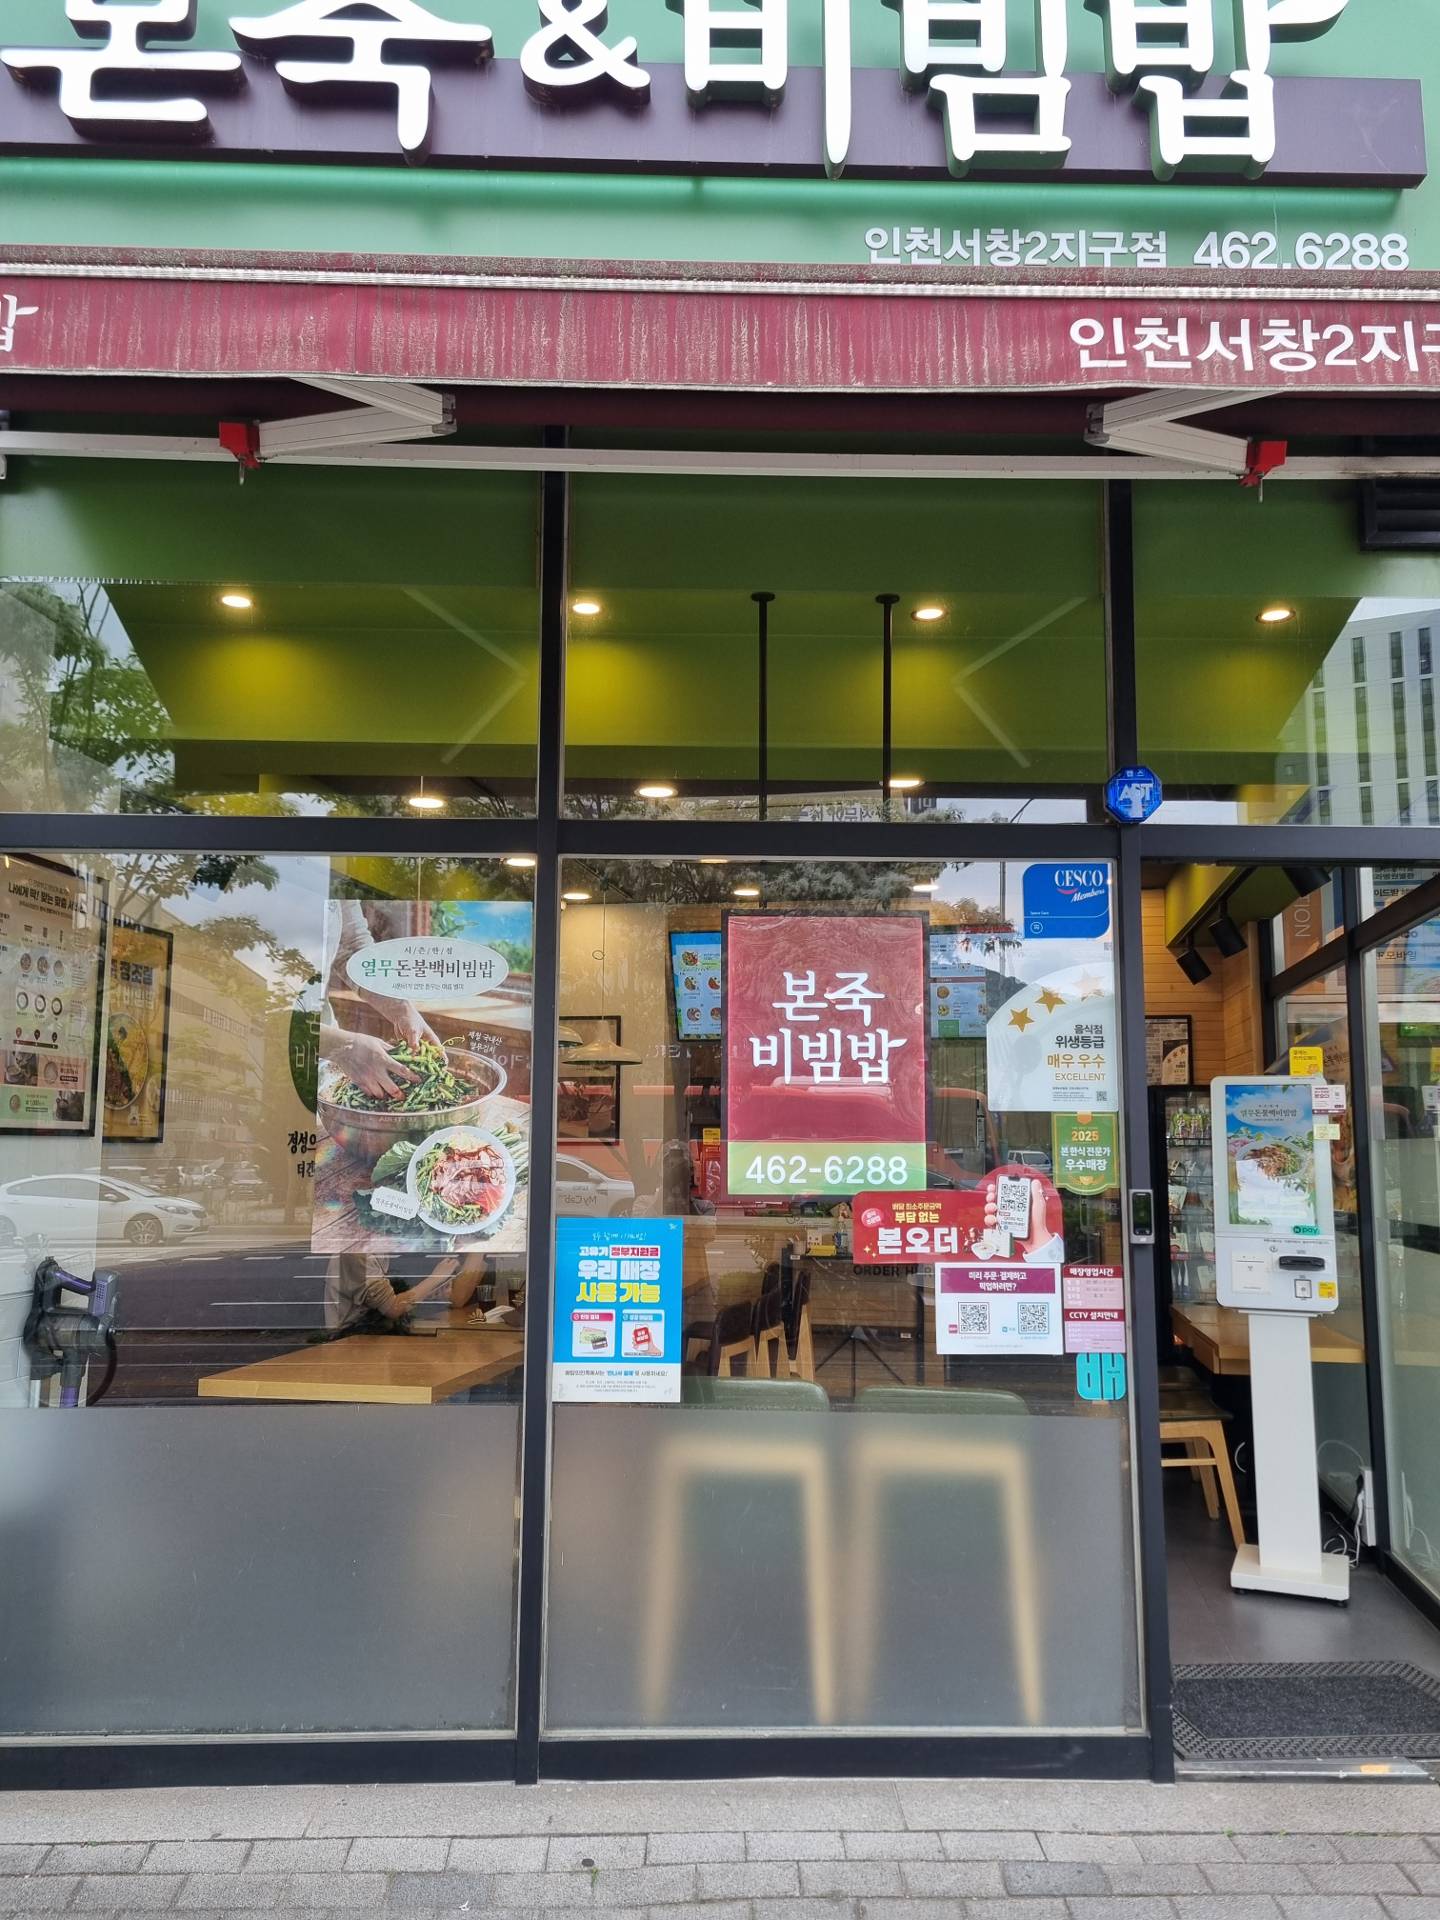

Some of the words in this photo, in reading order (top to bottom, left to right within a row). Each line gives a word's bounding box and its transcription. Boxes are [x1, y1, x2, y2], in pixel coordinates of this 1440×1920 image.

[864, 226, 1168, 268] 인천서창2지구점
[1193, 230, 1410, 271] 462.6288
[1054, 869, 1104, 887] CESCO
[1071, 888, 1106, 904] Members
[360, 958, 496, 979] 열무돈불백비빔밥
[771, 969, 886, 1028] 본죽
[1074, 1024, 1103, 1035] 음식점
[1055, 1035, 1105, 1049] 위생등급
[748, 1027, 908, 1086] 비빔밥
[1047, 1053, 1074, 1069] 매우
[1077, 1053, 1106, 1069] 우수
[1055, 1072, 1106, 1081] EXCELLENT
[1071, 1130, 1100, 1142] 2025
[744, 1155, 909, 1186] 462-6288
[1065, 1158, 1108, 1172] 우수매장
[894, 1211, 916, 1224] 부담
[918, 1211, 940, 1224] 없는
[877, 1227, 958, 1255] 본오더
[611, 1247, 660, 1258] 정부지원금
[577, 1260, 618, 1281] 우리
[620, 1260, 661, 1281] 매장
[968, 1271, 982, 1281] 미리
[1069, 1267, 1114, 1277] 매장영업시간
[576, 1282, 618, 1303] 사용
[619, 1282, 661, 1303] 가능
[1068, 1311, 1089, 1319] CCTV
